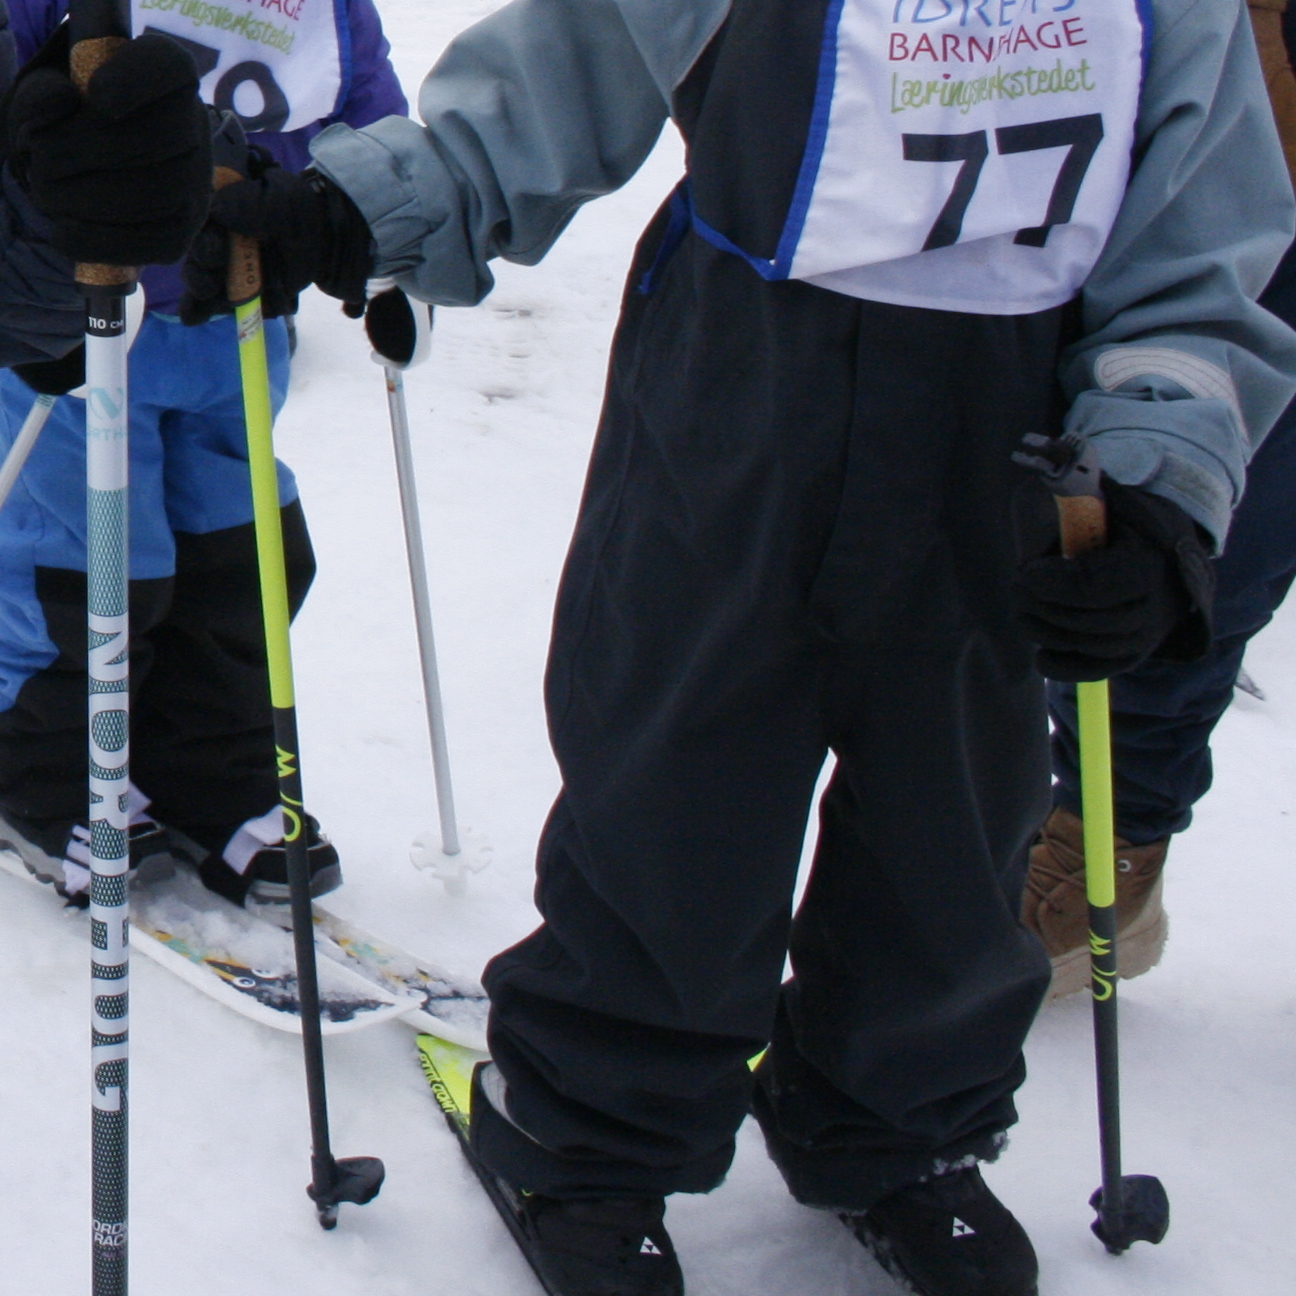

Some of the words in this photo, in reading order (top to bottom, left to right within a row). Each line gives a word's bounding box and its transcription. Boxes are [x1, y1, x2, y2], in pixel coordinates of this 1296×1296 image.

[902, 112, 1104, 253] 77
[88, 315, 106, 330] 110
[88, 612, 129, 1113] NORTHUG
